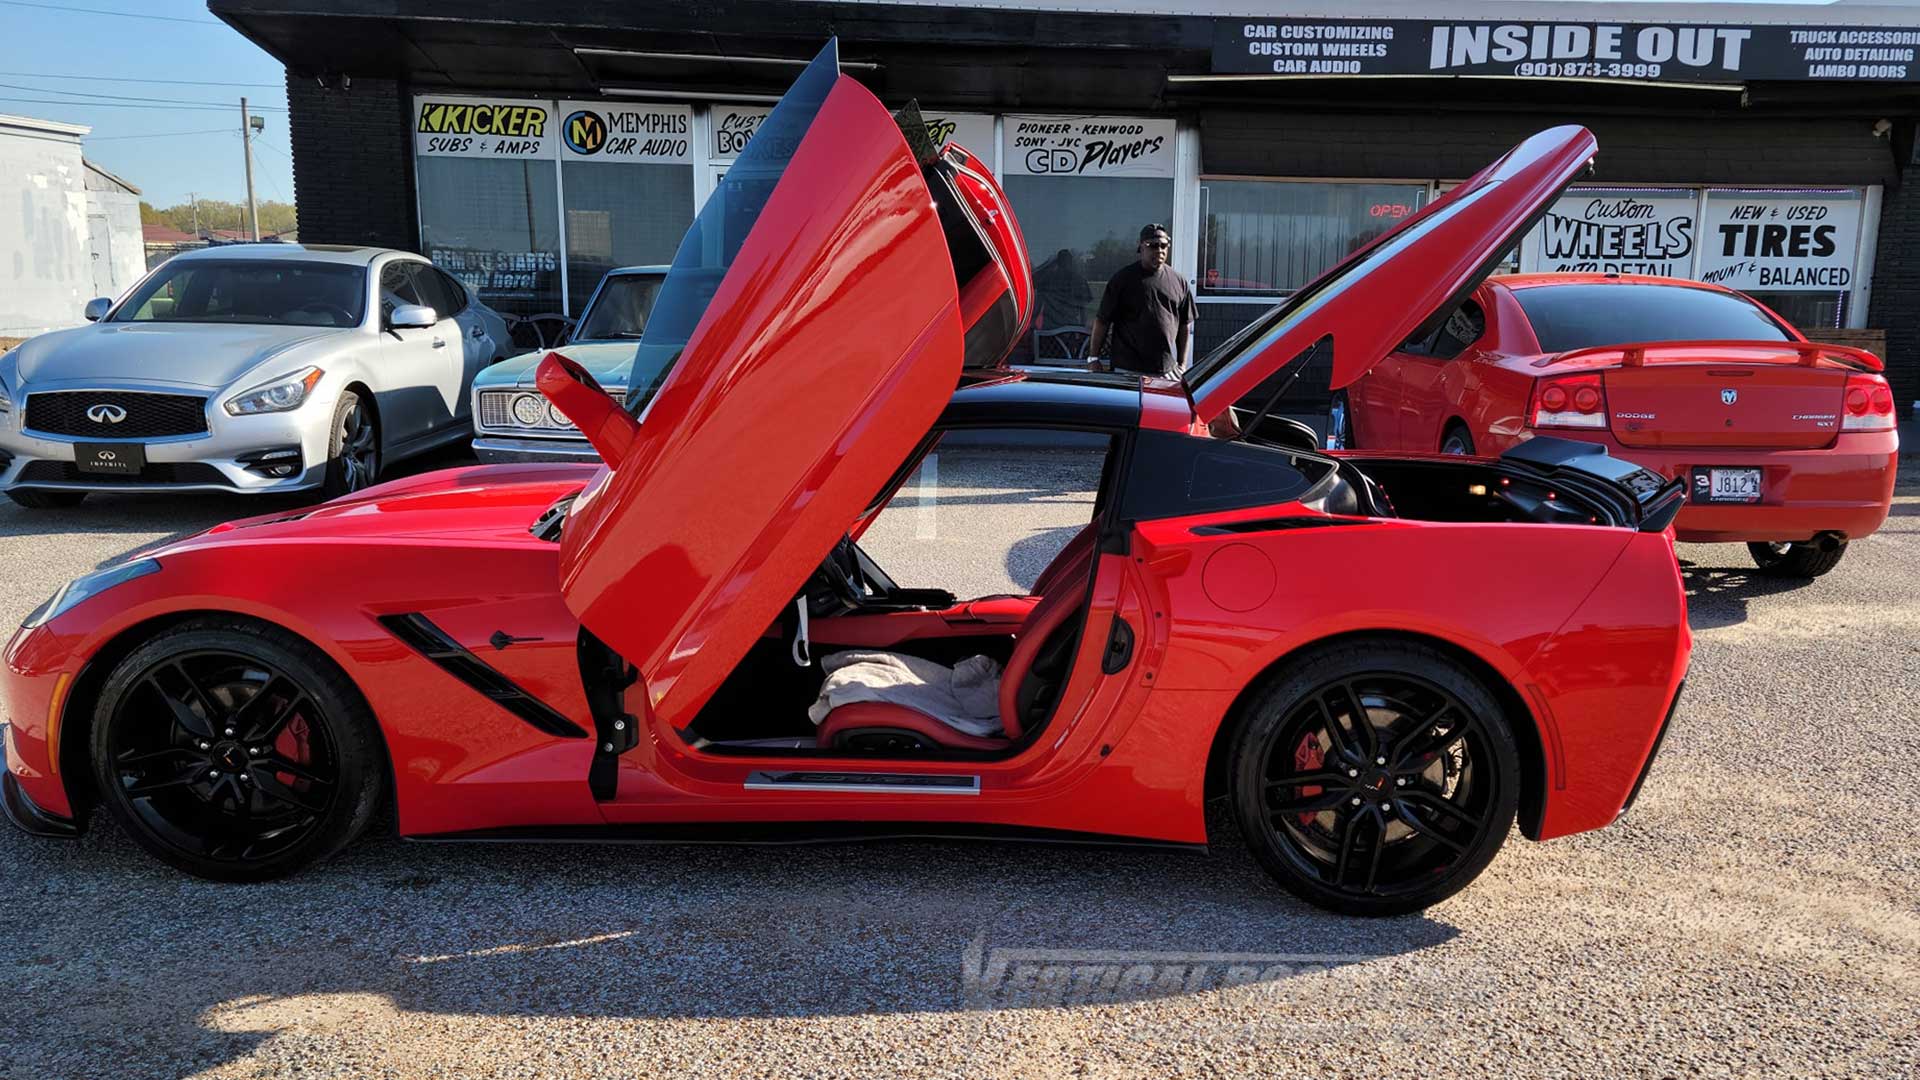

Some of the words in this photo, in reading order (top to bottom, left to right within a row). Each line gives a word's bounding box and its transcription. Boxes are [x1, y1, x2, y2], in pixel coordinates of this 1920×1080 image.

[1244, 25, 1277, 38] CAR
[1281, 25, 1394, 39] CUSTOMIZING
[1790, 30, 1838, 44] TRUCK
[1249, 42, 1319, 55] CUSTOM
[1322, 43, 1387, 56] WHEELS
[1430, 25, 1622, 69] INSIDE
[1636, 26, 1752, 71] OUT
[1804, 48, 1841, 60] AUTO
[1844, 48, 1914, 61] DETAILING
[1273, 60, 1307, 73] CAR
[1310, 60, 1361, 73] AUDIO
[1514, 62, 1661, 77] (901)873-3999
[1808, 64, 1856, 77] LAMBO
[1859, 65, 1907, 78] DOORS
[607, 112, 687, 133] MEMPHIS
[721, 113, 768, 130] CUST
[1017, 123, 1071, 134] PIONEER
[1081, 124, 1144, 135] KENWOOD
[428, 137, 473, 152] SUBS
[494, 140, 540, 154] AMPS
[606, 137, 637, 155] CAR
[640, 139, 688, 157] AUDIO
[1014, 136, 1047, 147] SONY
[1058, 138, 1081, 147] JVC
[1025, 148, 1078, 174] CD
[1078, 136, 1164, 174] Players
[1370, 204, 1411, 217] OPEN
[1585, 199, 1655, 221] Custom
[1730, 205, 1767, 220] NEW
[1771, 208, 1780, 220] &
[1786, 206, 1828, 220] USED
[1544, 212, 1693, 260] WHEELS
[1719, 224, 1837, 257] TIRES
[497, 252, 556, 271] STARTS
[493, 271, 537, 288] here!
[1702, 261, 1749, 283] MOUNT
[1759, 267, 1850, 286] BALANCED
[1716, 477, 1747, 493] J812
